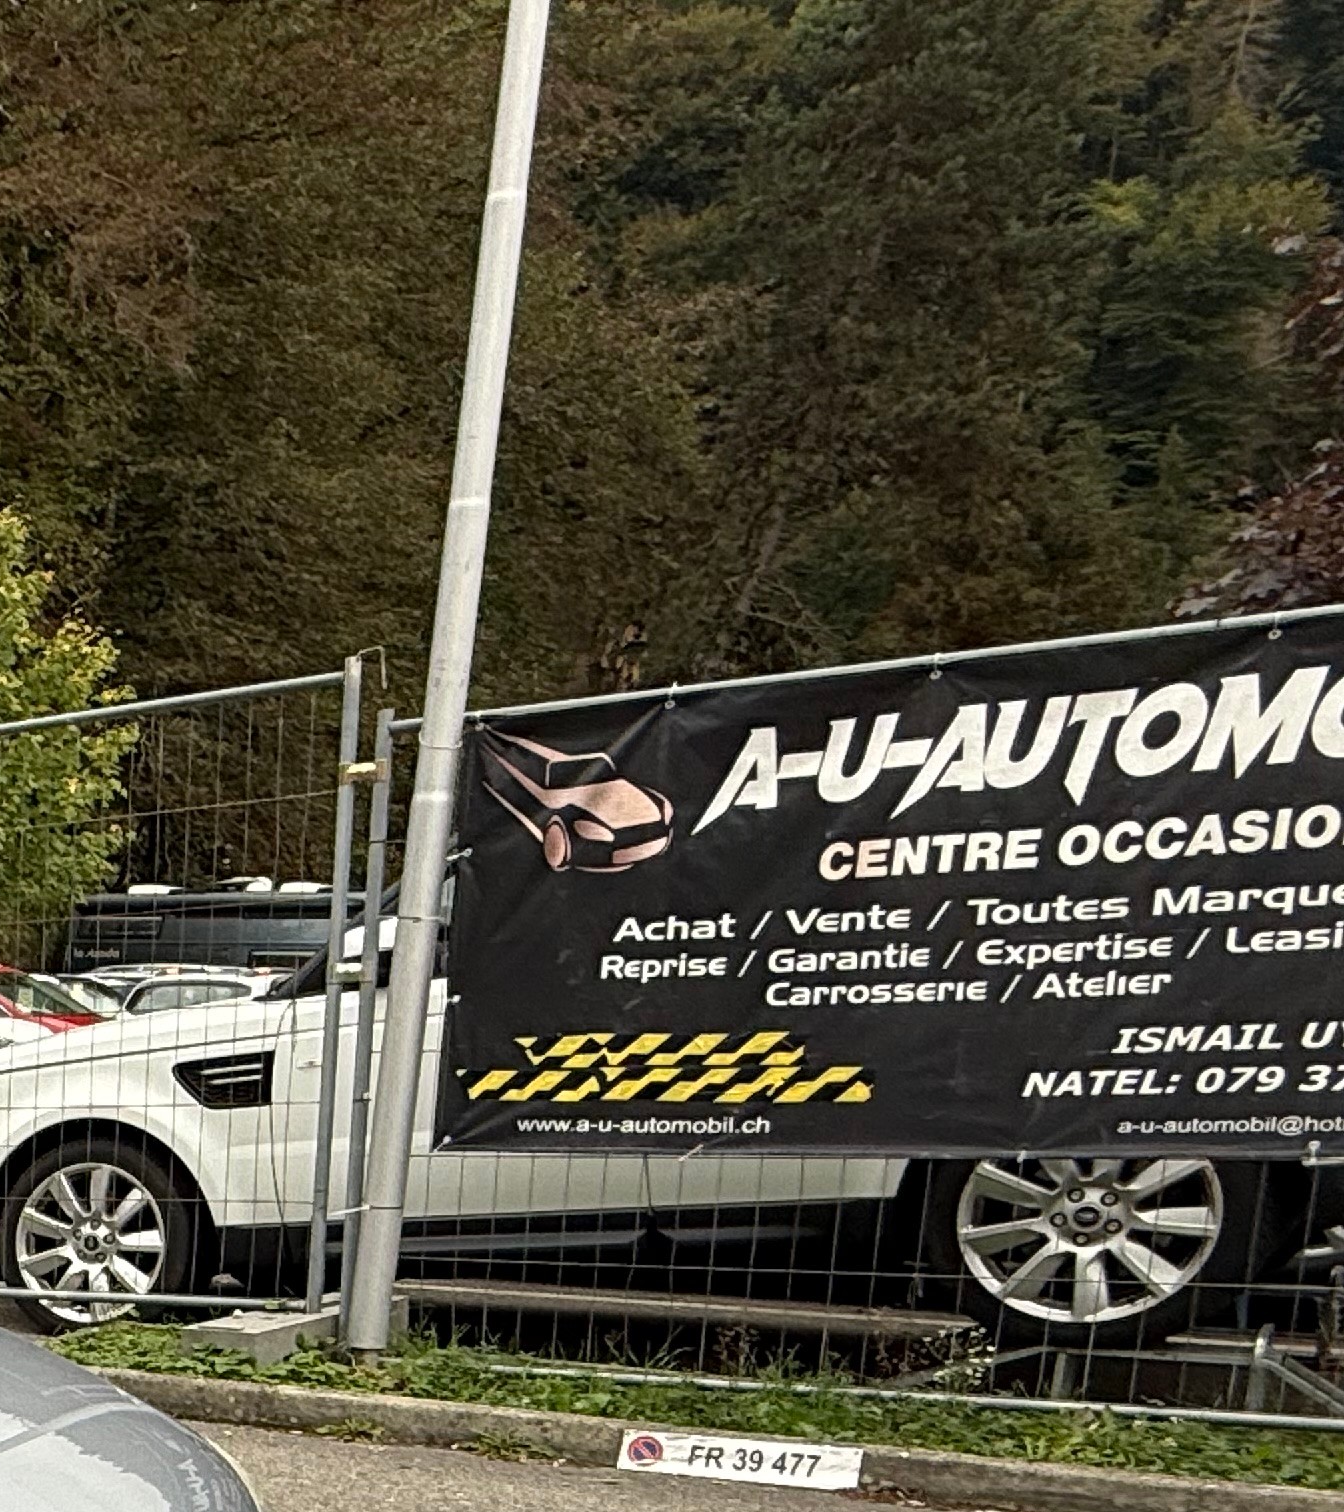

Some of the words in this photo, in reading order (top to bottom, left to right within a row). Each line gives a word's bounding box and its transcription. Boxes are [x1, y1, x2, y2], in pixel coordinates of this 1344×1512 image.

[819, 828, 1042, 881] CENTRE
[613, 913, 737, 942] Achat
[786, 904, 912, 935] Vente
[967, 895, 1130, 926] Toutes
[601, 953, 728, 983] Reprise
[768, 943, 931, 974] Garantie
[977, 933, 1173, 969] Expertise
[766, 980, 988, 1006] Carrosserie
[1032, 970, 1172, 999] Atelier
[1111, 1022, 1284, 1053] ISMAIL
[1301, 1020, 1344, 1049] U
[1021, 1069, 1182, 1098] NATEL:
[1195, 1066, 1286, 1094] 079
[516, 1116, 771, 1134] www.a-u-automobil.ch
[1117, 1115, 1344, 1136] a-u-automobil@hot
[688, 1445, 724, 1469] FR
[732, 1448, 764, 1472] 39
[771, 1452, 822, 1477] 477
